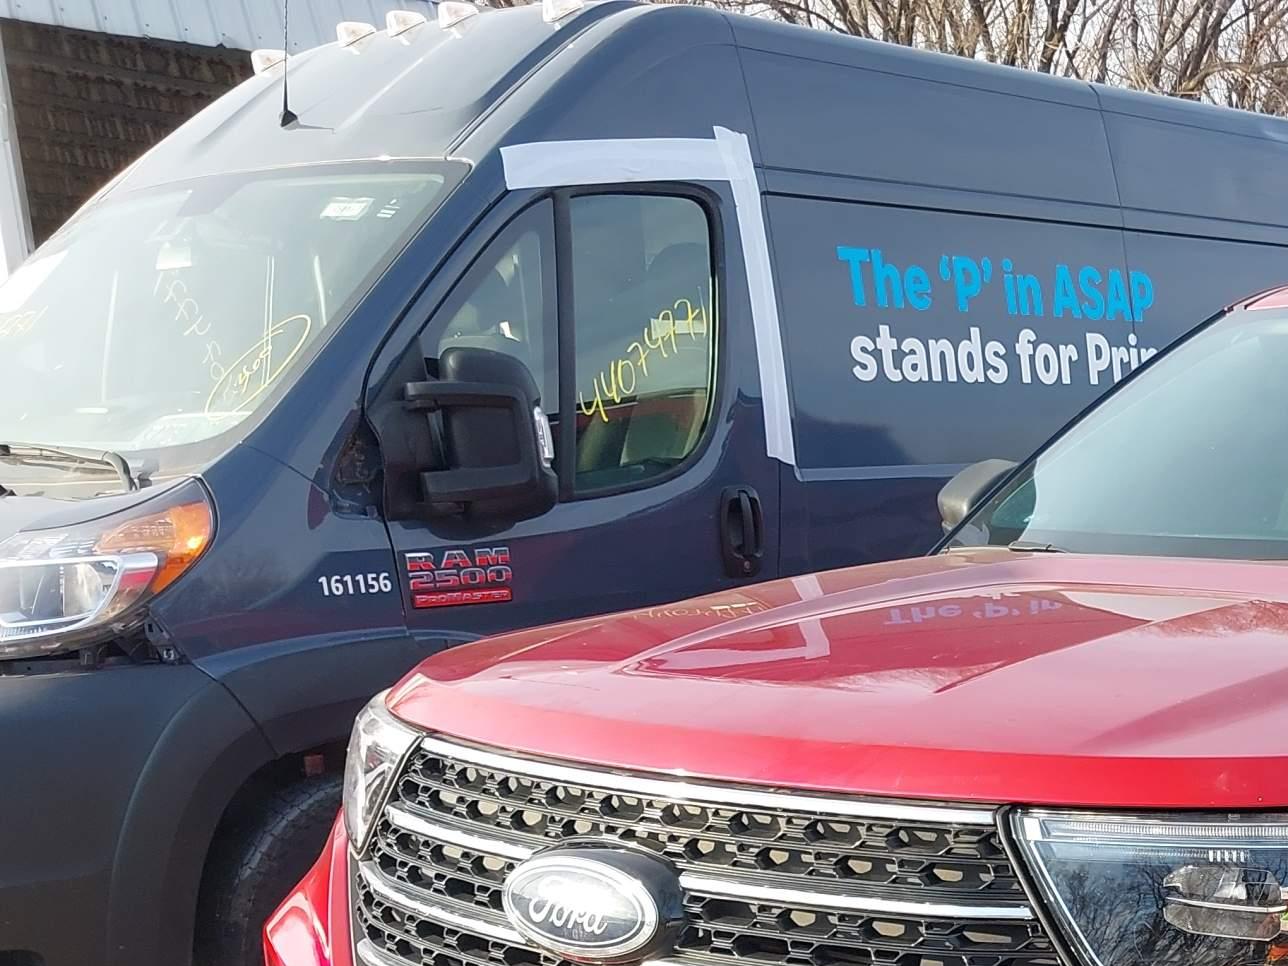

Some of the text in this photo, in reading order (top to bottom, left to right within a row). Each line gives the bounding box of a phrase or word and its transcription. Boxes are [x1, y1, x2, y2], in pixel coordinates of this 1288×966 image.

[837, 245, 932, 310] The
[1002, 258, 1044, 318] in
[1053, 263, 1154, 322] ASAP
[850, 324, 1008, 384] stands
[1015, 328, 1079, 385] for
[404, 546, 511, 571] RAM
[317, 572, 392, 597] 161156
[408, 565, 513, 591] 2500
